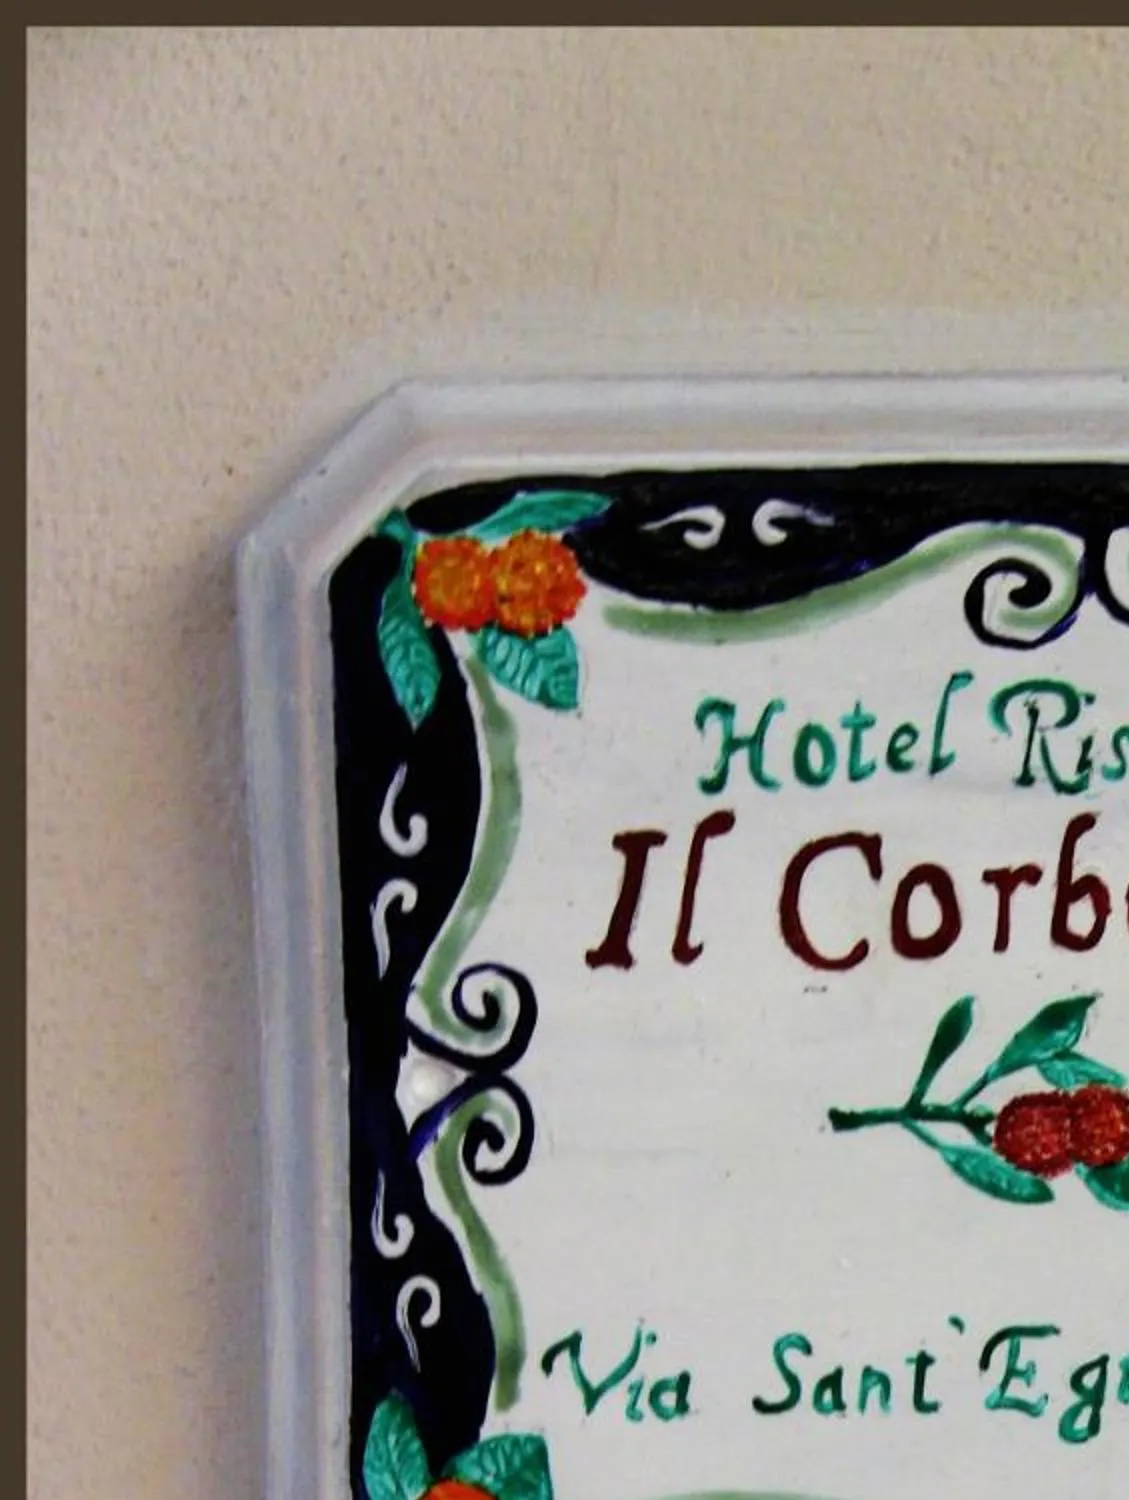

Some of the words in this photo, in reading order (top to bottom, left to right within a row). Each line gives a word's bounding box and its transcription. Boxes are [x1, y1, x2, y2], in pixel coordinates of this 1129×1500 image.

[692, 669, 976, 797] Hotel
[583, 807, 737, 973] Il
[539, 1328, 693, 1424] Via
